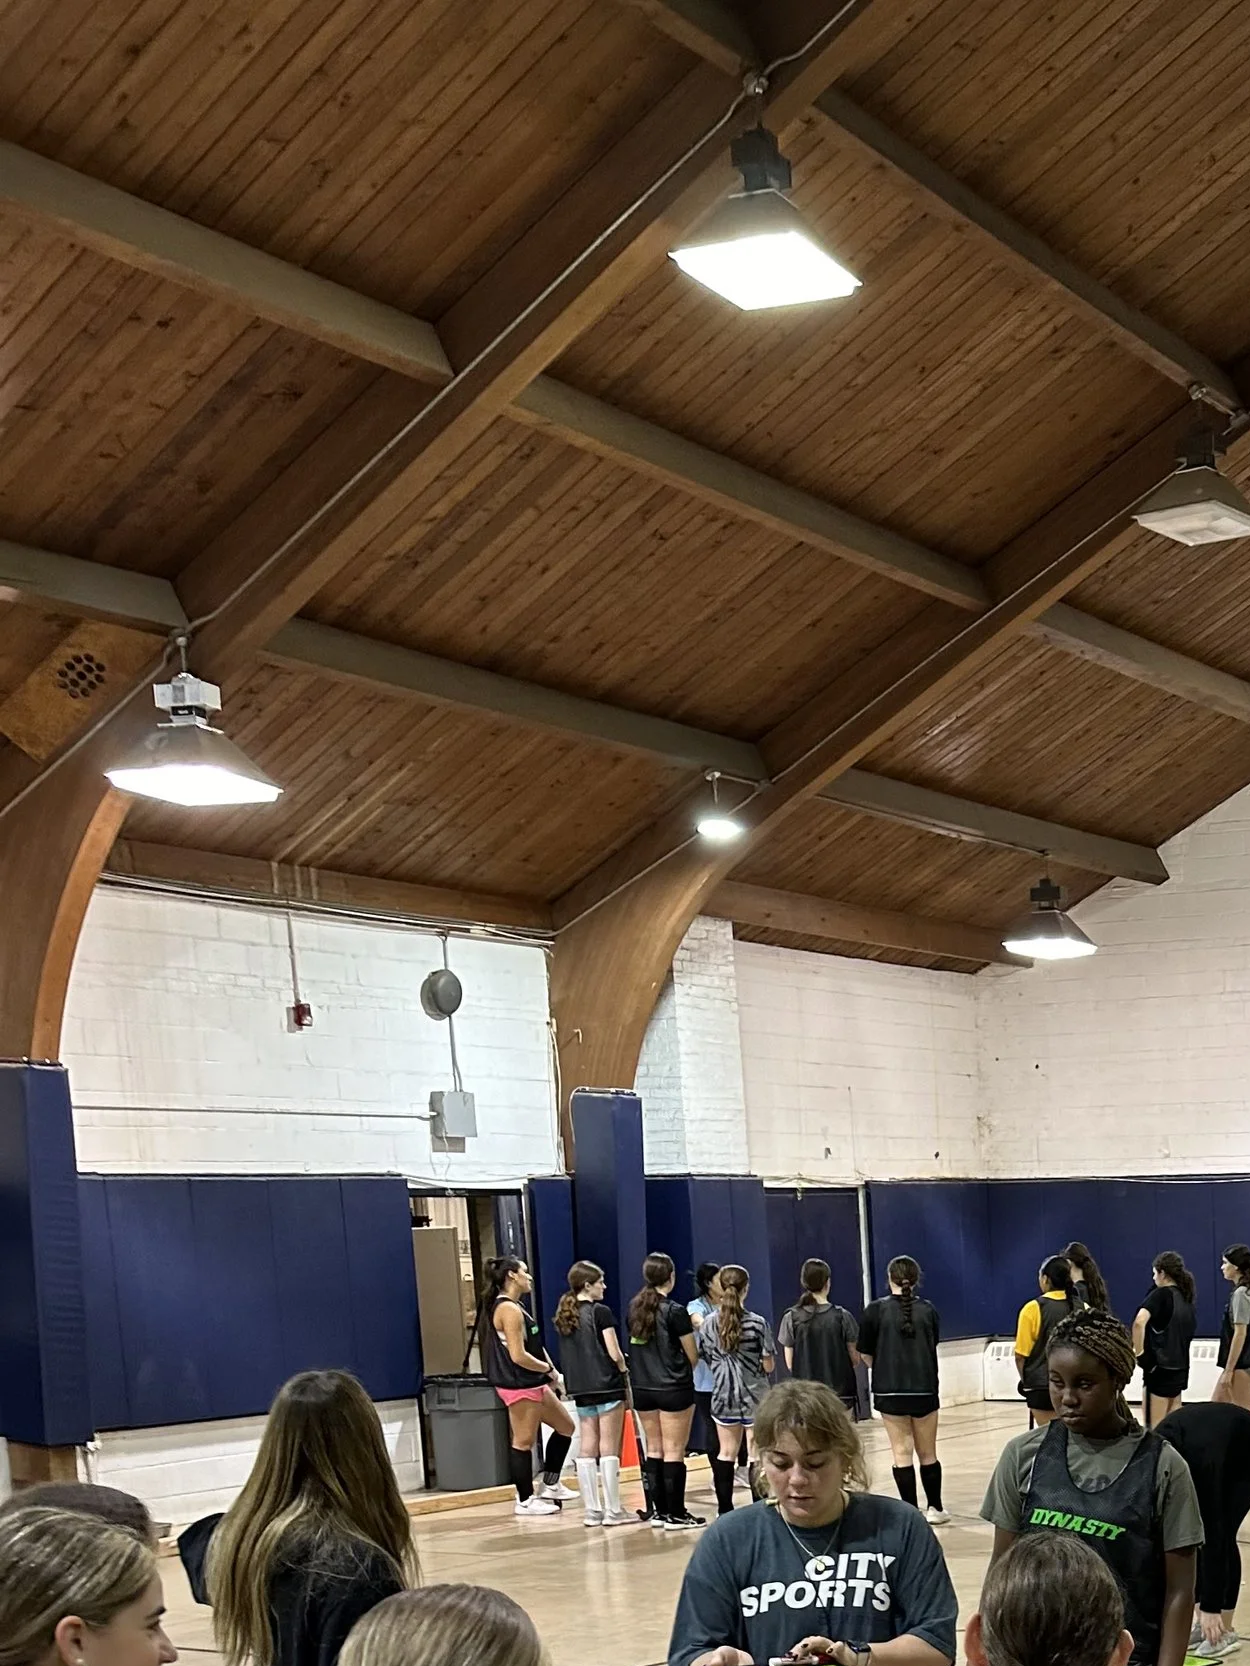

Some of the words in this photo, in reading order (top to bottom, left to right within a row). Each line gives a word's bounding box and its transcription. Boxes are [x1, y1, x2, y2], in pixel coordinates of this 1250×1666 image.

[1029, 1508, 1126, 1541] DYNASTY
[805, 1552, 896, 1582] CITY
[740, 1580, 891, 1617] SPORTS
